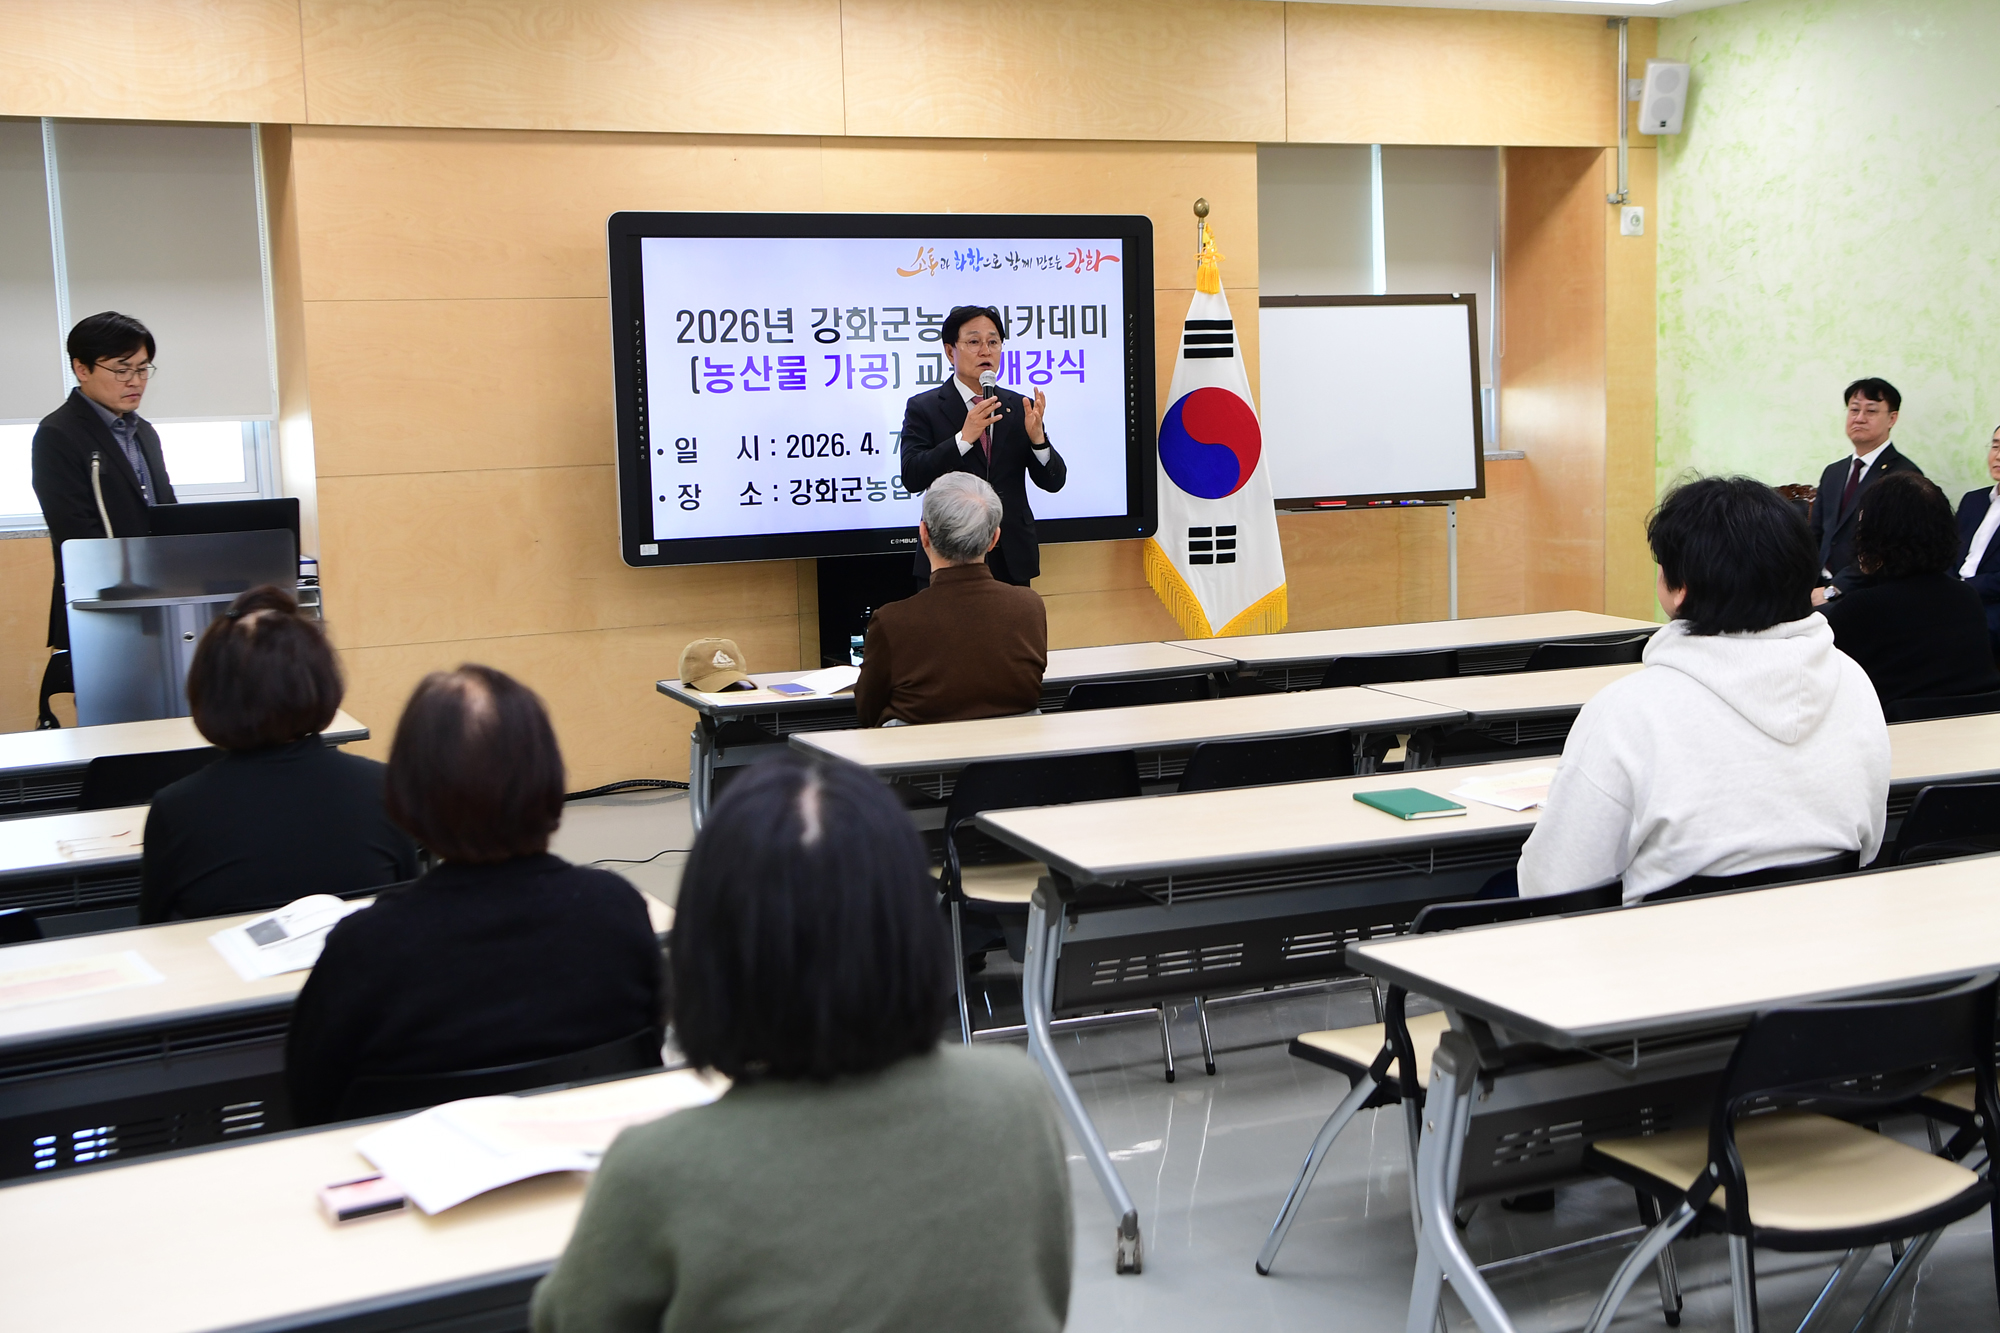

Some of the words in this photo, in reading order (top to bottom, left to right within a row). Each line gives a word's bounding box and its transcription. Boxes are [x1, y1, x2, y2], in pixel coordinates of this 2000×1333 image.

[1005, 250, 1033, 271] 함께
[1036, 254, 1063, 270] 만드는
[1065, 247, 1121, 274] 강화
[676, 307, 794, 344] 2026년
[915, 352, 955, 385] 교
[675, 437, 698, 463] 일
[736, 435, 760, 461] 시
[786, 432, 851, 459] 2026.
[860, 432, 880, 455] 4.
[677, 484, 701, 511] 장
[739, 481, 763, 506] 소
